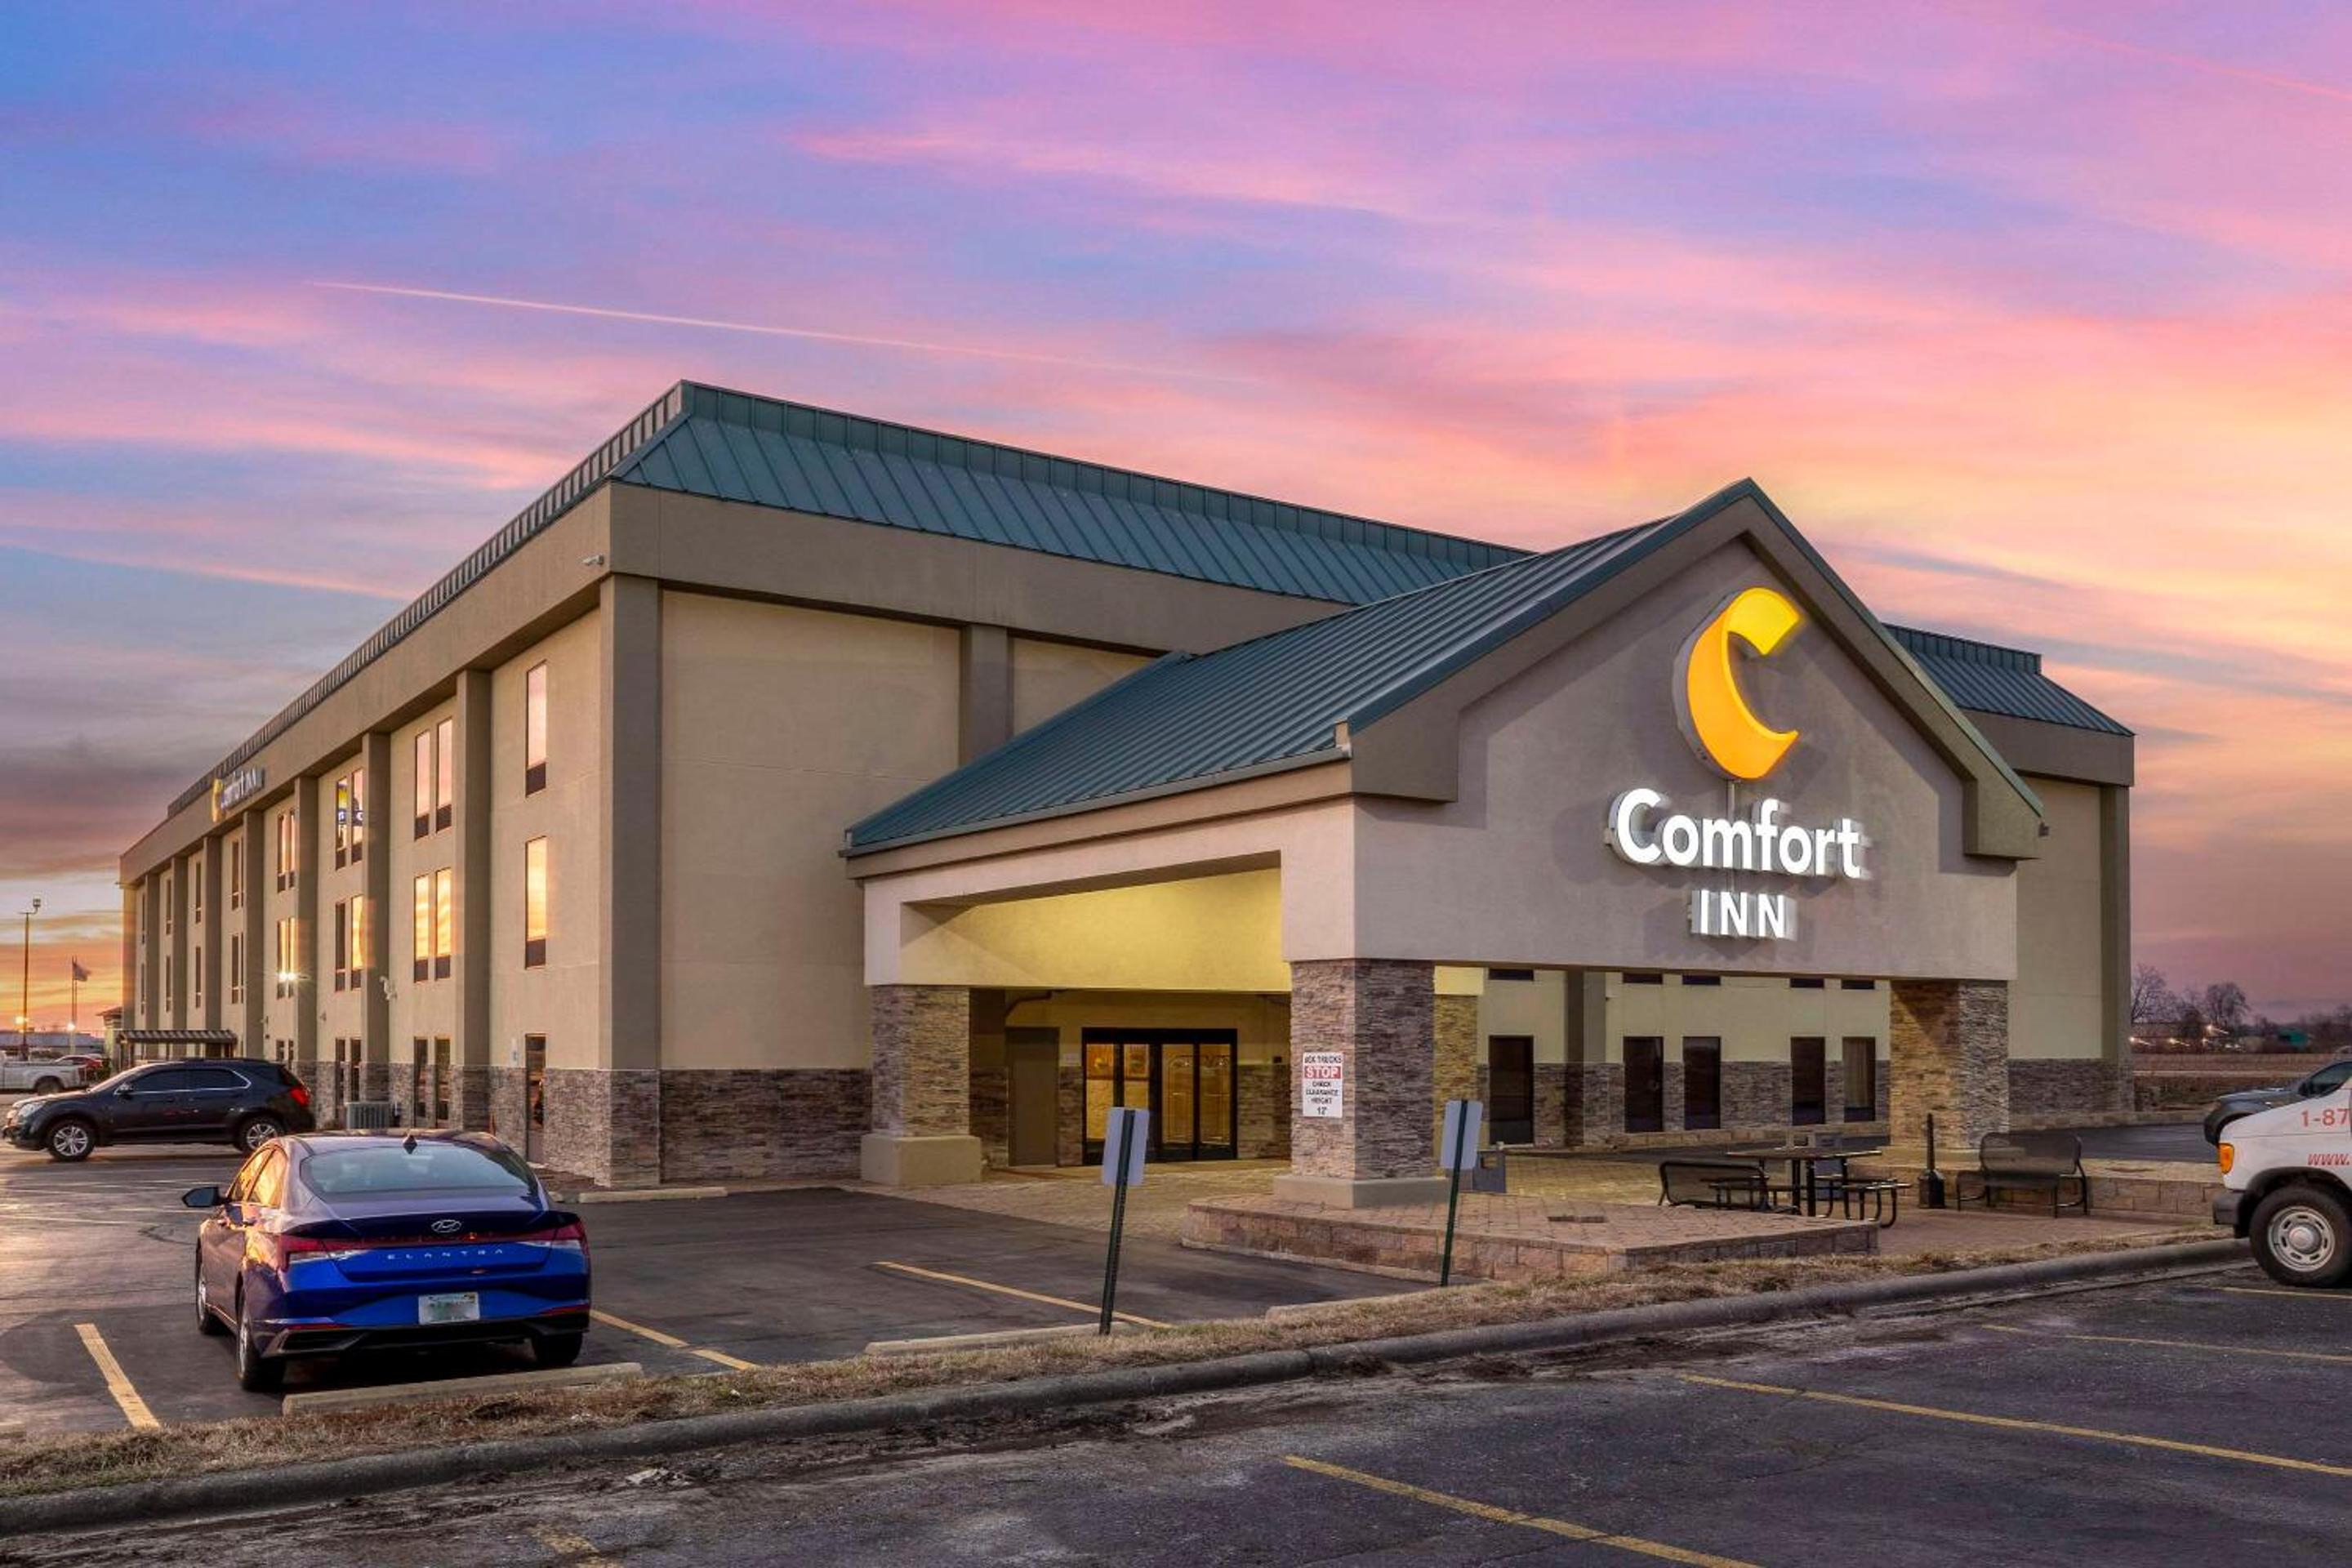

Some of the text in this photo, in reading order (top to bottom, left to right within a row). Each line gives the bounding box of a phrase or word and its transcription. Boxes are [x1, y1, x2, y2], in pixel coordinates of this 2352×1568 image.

[1611, 787, 1864, 879] Comfort
[1698, 889, 1787, 939] INN
[1306, 1067, 1339, 1078] STOP
[387, 1248, 503, 1260] ELANTRA
